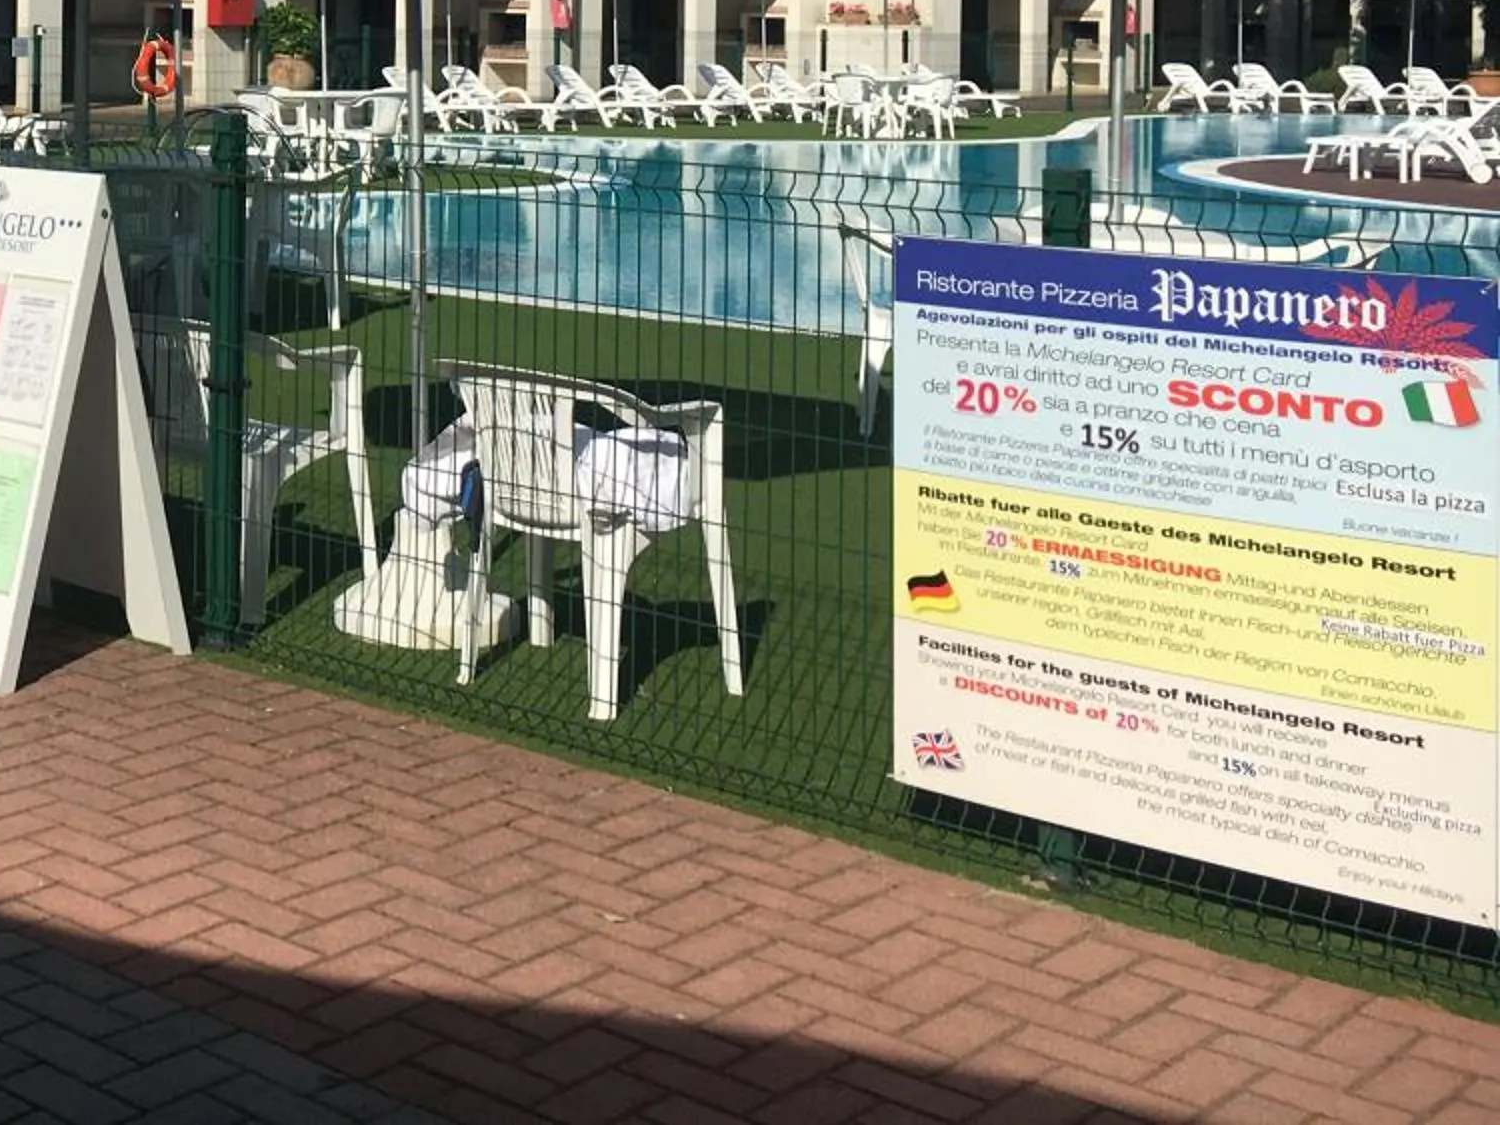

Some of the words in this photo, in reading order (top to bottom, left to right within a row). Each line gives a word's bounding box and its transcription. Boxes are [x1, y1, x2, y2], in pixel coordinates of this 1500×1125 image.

[916, 270, 1034, 300] Ristorante
[1040, 282, 1139, 310] Pizzeria
[1148, 269, 1388, 335] Papanero
[916, 308, 1029, 330] Agevolazioni
[1033, 322, 1067, 334] per
[1073, 325, 1096, 339] gli
[1102, 330, 1158, 344] ospiti
[1164, 334, 1196, 348] del
[1203, 337, 1353, 363] Michelangelo
[916, 329, 1000, 354] Presenta
[1005, 339, 1021, 356] la
[1025, 342, 1165, 373] Michelangelo
[1171, 357, 1245, 381] Resort
[1253, 366, 1311, 388] Card
[922, 378, 950, 395] del
[1042, 395, 1069, 411] sia
[1075, 400, 1088, 414] a
[1093, 402, 1168, 425] pranzo
[1174, 410, 1217, 430] che
[1222, 418, 1281, 438] cena
[973, 362, 1019, 380] avrai
[1023, 366, 1082, 387] diritto
[1084, 374, 1112, 392] ad
[1117, 380, 1159, 397] uno
[1166, 380, 1384, 427] SCONTO
[931, 425, 997, 445] Ristorante
[999, 434, 1049, 453] Pizzeria
[1233, 469, 1247, 480] di
[1059, 423, 1072, 436] e
[1080, 423, 1140, 454] 15%
[1150, 435, 1176, 450] su
[1182, 436, 1224, 457] tutti
[1241, 446, 1309, 468] menù
[1315, 453, 1435, 483] d'asporto
[1202, 481, 1232, 493] con
[1335, 478, 1405, 503] Esclusa
[1411, 488, 1427, 506] la
[1435, 495, 1485, 515] pizza
[917, 485, 985, 507] Ribatte
[991, 498, 1030, 514] fuer
[1036, 507, 1072, 522] alle
[1077, 512, 1154, 535] Gaeste
[1160, 526, 1201, 543] des
[1208, 532, 1363, 567] Michelangelo
[1371, 556, 1457, 580] Resort
[965, 510, 1056, 536] Michelangelo
[1059, 525, 1108, 544] Resort
[1110, 534, 1148, 551] Card
[1031, 538, 1222, 582] ERMAESSIGUNG
[1320, 587, 1429, 615] Abendessen
[1050, 559, 1081, 578] 15%
[1123, 571, 1210, 595] Mitnehmen
[1072, 586, 1145, 610] Papanero
[1203, 647, 1230, 660] der
[1233, 650, 1292, 672] Region
[1297, 664, 1328, 679] von
[1320, 618, 1359, 635] Keine
[1363, 624, 1410, 643] Rabatt
[1413, 632, 1444, 648] fuer
[1449, 639, 1485, 656] Pizza
[918, 634, 1000, 663] Facilities
[1007, 654, 1035, 670] for
[1040, 661, 1072, 678] the
[1079, 672, 1150, 695] guests
[1157, 686, 1178, 700] of
[1184, 691, 1335, 731] Michelangelo
[1343, 721, 1425, 748] Resort
[1107, 692, 1157, 714] Resort
[1206, 715, 1237, 730] you
[1240, 723, 1264, 736] will
[953, 676, 1078, 714] DISCOUNTS
[1085, 706, 1107, 721] of
[1166, 723, 1187, 738] for
[1191, 729, 1228, 747] both
[1231, 737, 1275, 757] lunch
[1279, 749, 1311, 765] and
[1147, 764, 1222, 791] Papanero
[1221, 756, 1257, 777] 15%
[1258, 764, 1279, 778] on
[1303, 772, 1384, 803] takeaway
[1388, 791, 1450, 813] menus
[1373, 800, 1441, 829] Excluding
[1445, 819, 1481, 835] pizza
